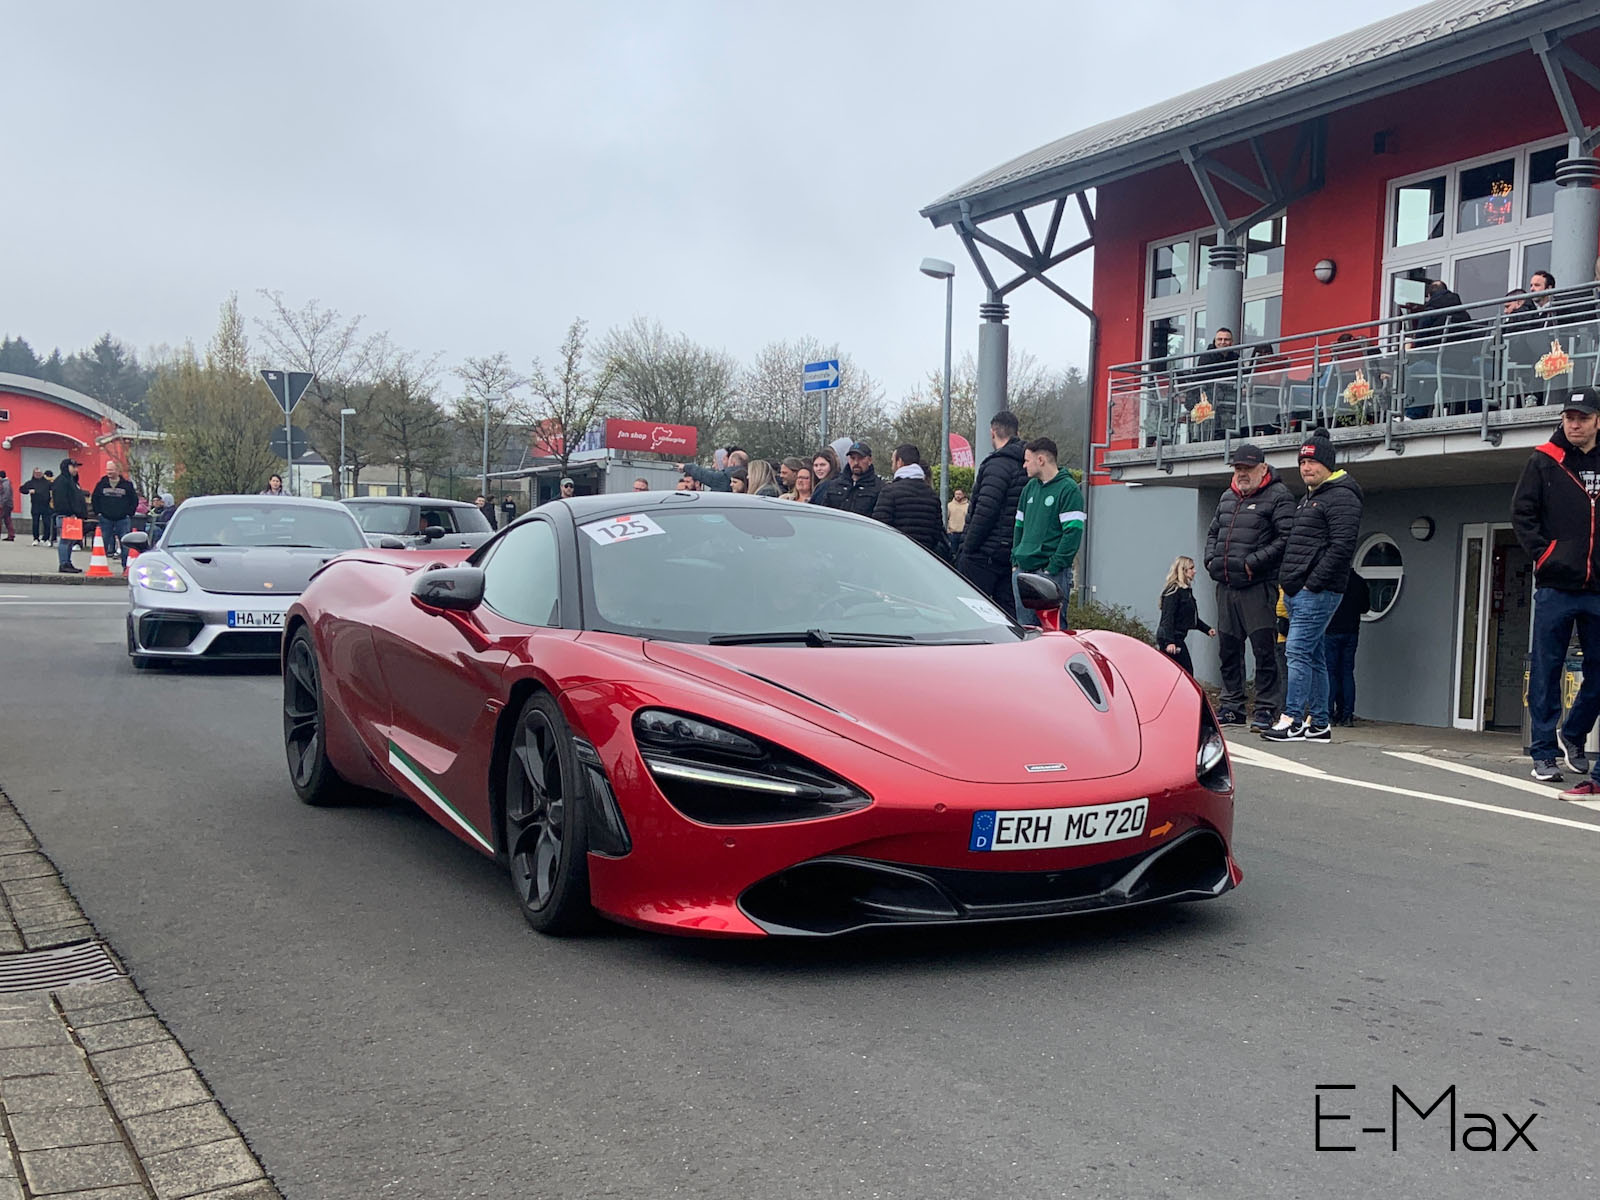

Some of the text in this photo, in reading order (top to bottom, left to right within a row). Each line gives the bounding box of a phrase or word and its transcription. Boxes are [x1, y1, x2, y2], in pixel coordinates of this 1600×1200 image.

[617, 430, 629, 438] fan
[630, 431, 647, 440] shop
[597, 520, 649, 539] 125
[237, 613, 254, 625] HA
[263, 613, 281, 625] MZ
[977, 805, 1145, 848] D ERH MC 720
